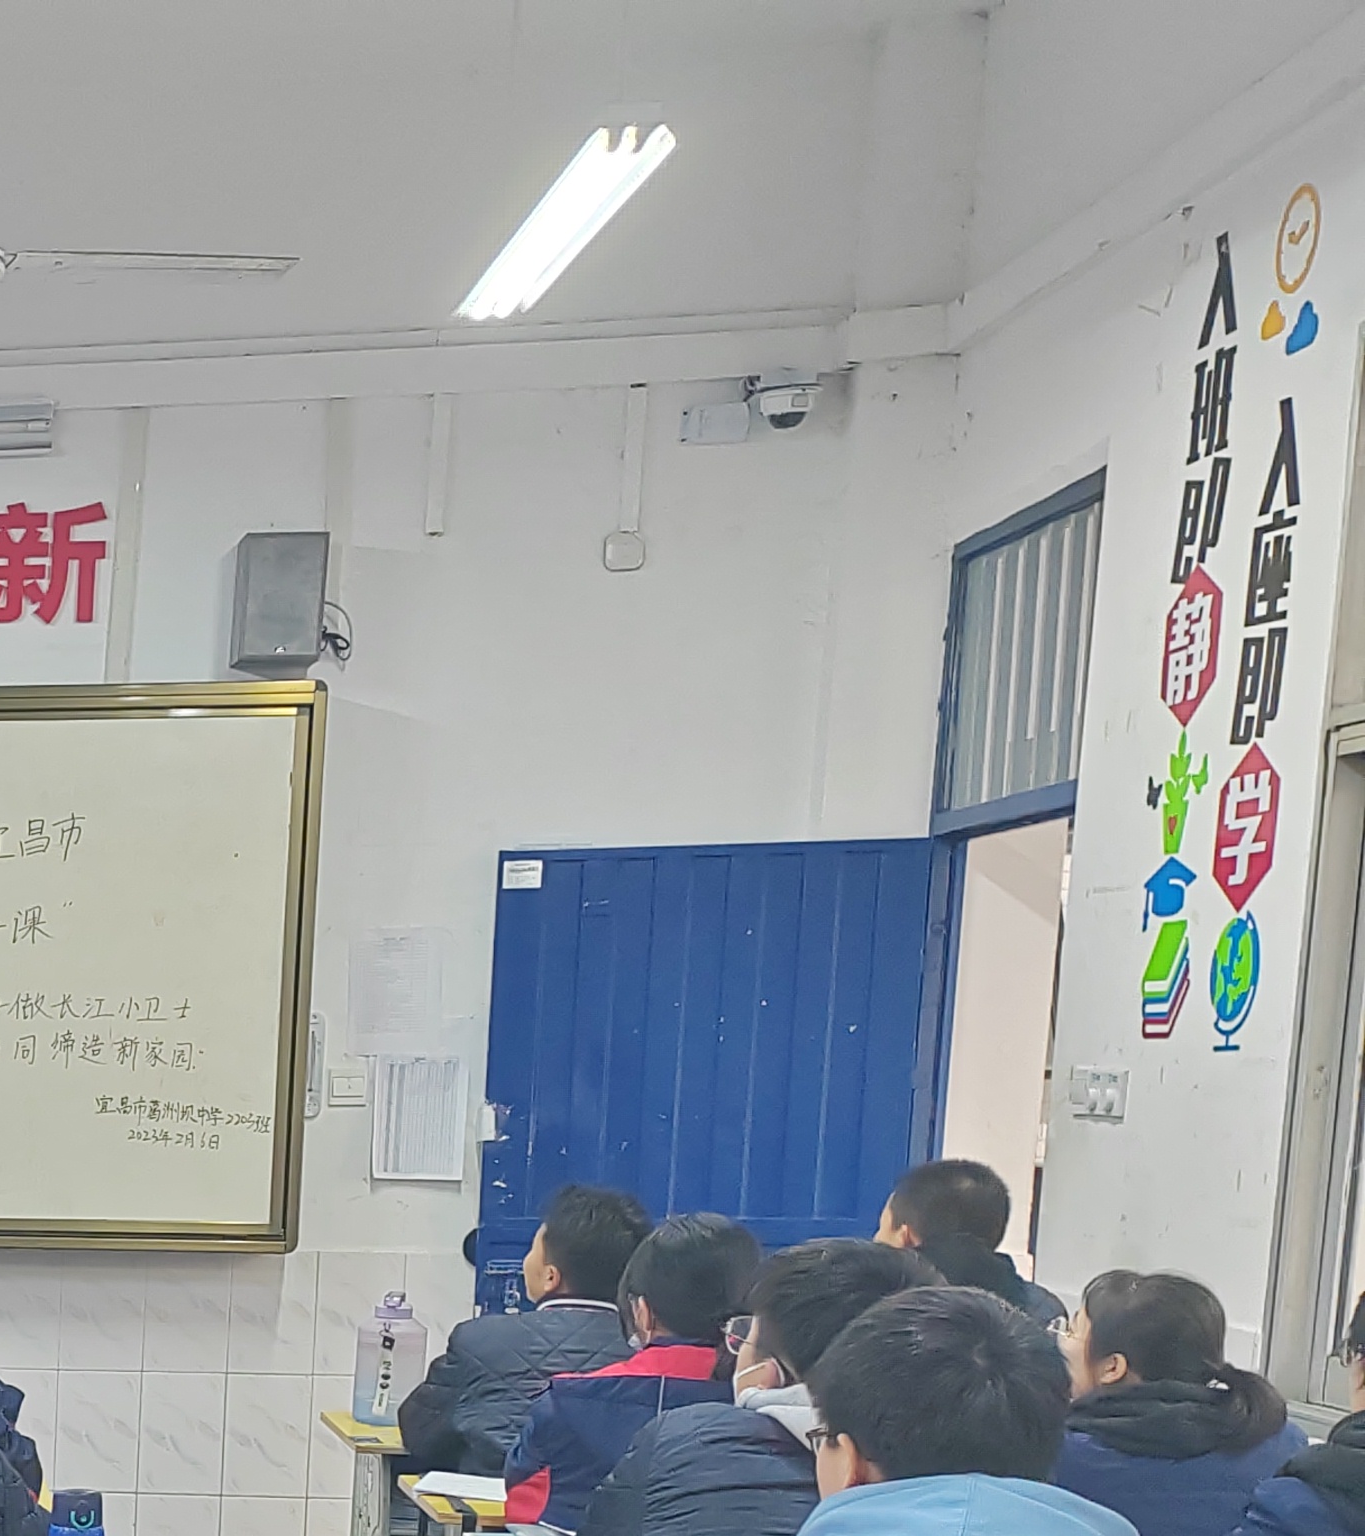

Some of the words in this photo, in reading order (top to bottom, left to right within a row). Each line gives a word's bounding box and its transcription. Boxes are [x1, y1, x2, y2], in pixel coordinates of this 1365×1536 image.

[1166, 231, 1238, 706] 入班即静
[1221, 397, 1301, 887] 入座即学
[127, 1129, 221, 1150] 2023年2月6日
